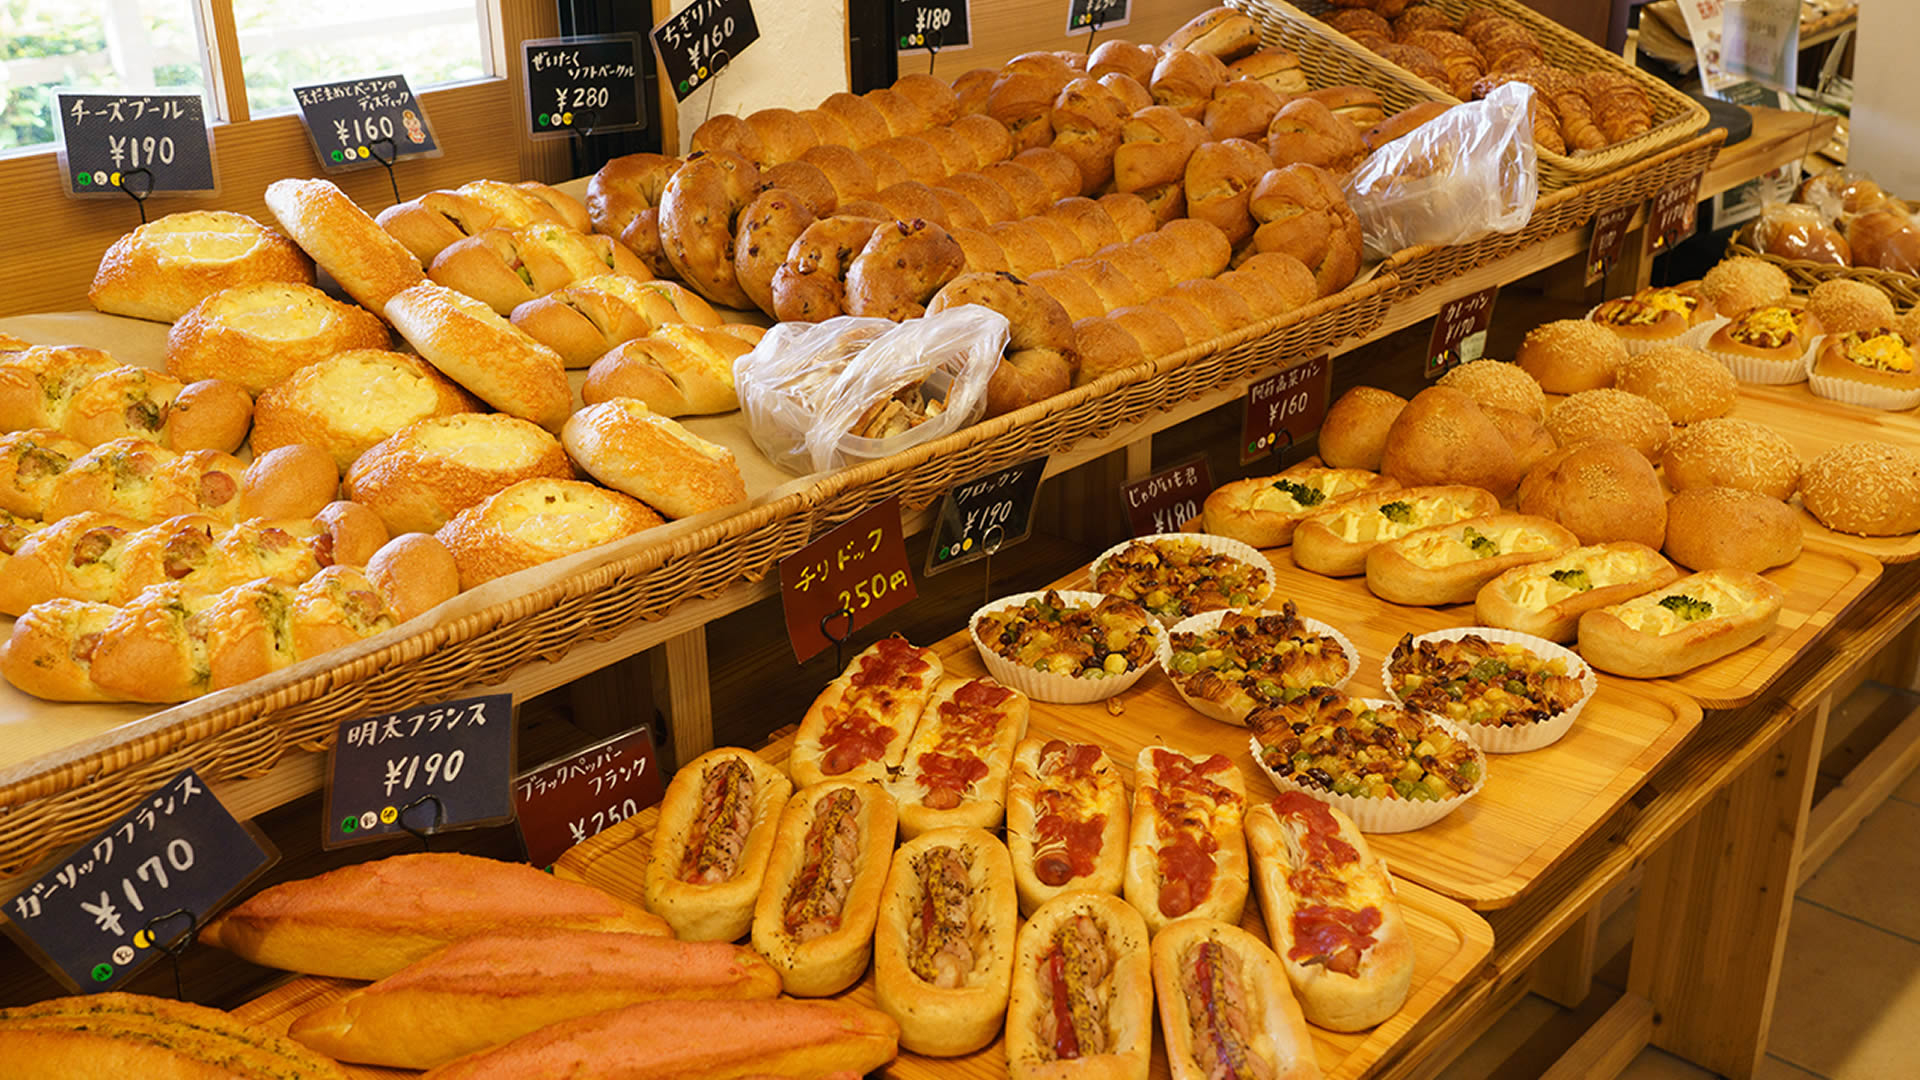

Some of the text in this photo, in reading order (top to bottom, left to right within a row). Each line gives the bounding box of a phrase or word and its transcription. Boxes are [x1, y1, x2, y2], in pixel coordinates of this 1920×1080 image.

[663, 0, 729, 50] ちぎり
[915, 7, 952, 33] ¥180
[531, 51, 580, 72] ぜいたく
[687, 17, 735, 71] ¥160
[71, 97, 184, 126] チーズブール
[297, 80, 397, 106] えだまめとベーコンの
[555, 87, 609, 113] ¥280
[333, 116, 394, 146] ¥160
[108, 135, 175, 168] ¥190
[1269, 391, 1309, 427] ¥160
[963, 500, 1013, 539] ¥190
[1152, 500, 1197, 534] ¥180
[838, 569, 908, 617] 250円
[346, 702, 488, 748] 明太フランス
[383, 749, 465, 797] ¥190
[518, 745, 622, 802] ブラックペッパー
[588, 756, 646, 796] フランク
[568, 798, 637, 845] ¥250
[15, 775, 202, 919] ガーリックフランス
[80, 838, 195, 936] ¥170
